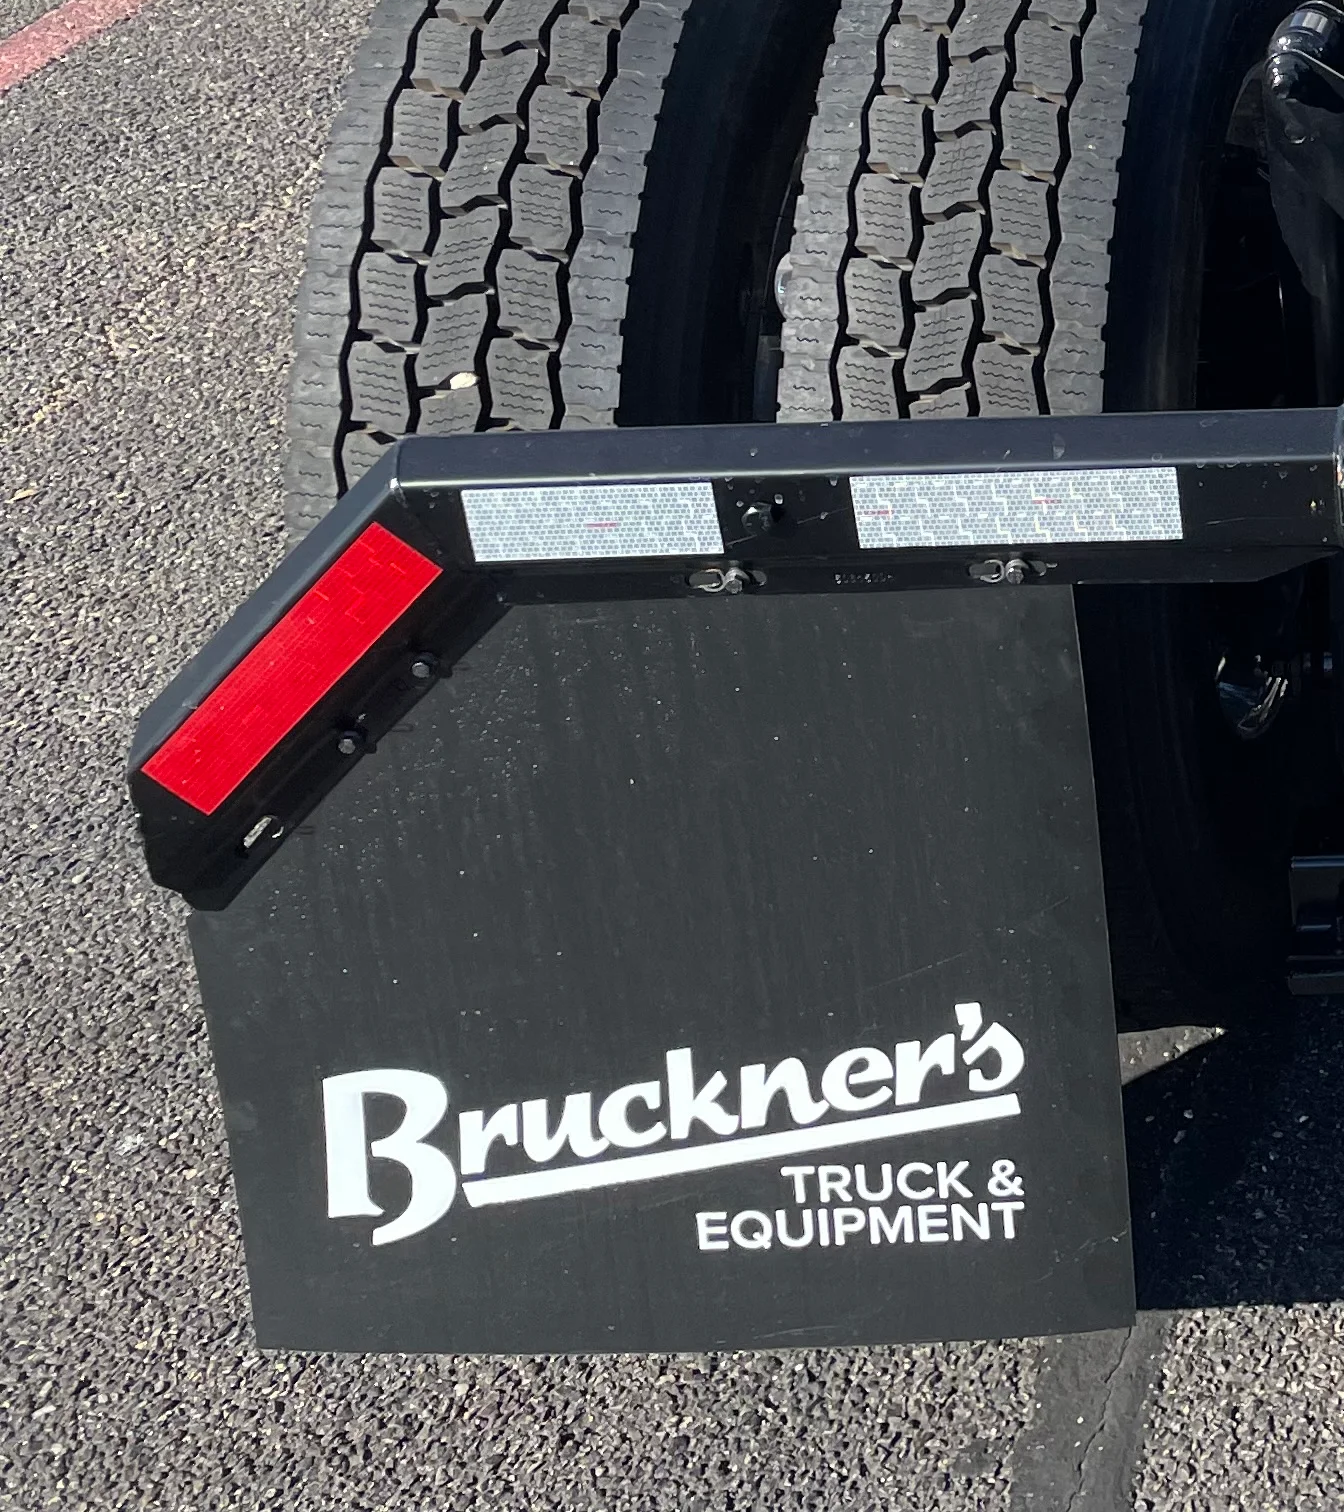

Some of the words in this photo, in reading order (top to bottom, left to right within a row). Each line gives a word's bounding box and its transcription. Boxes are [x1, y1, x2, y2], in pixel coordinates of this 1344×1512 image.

[322, 1002, 1025, 1246] Bruckner's
[781, 1161, 973, 1205] TRUCK
[989, 1159, 1025, 1197] &
[695, 1201, 1025, 1251] EQUIPMENT
